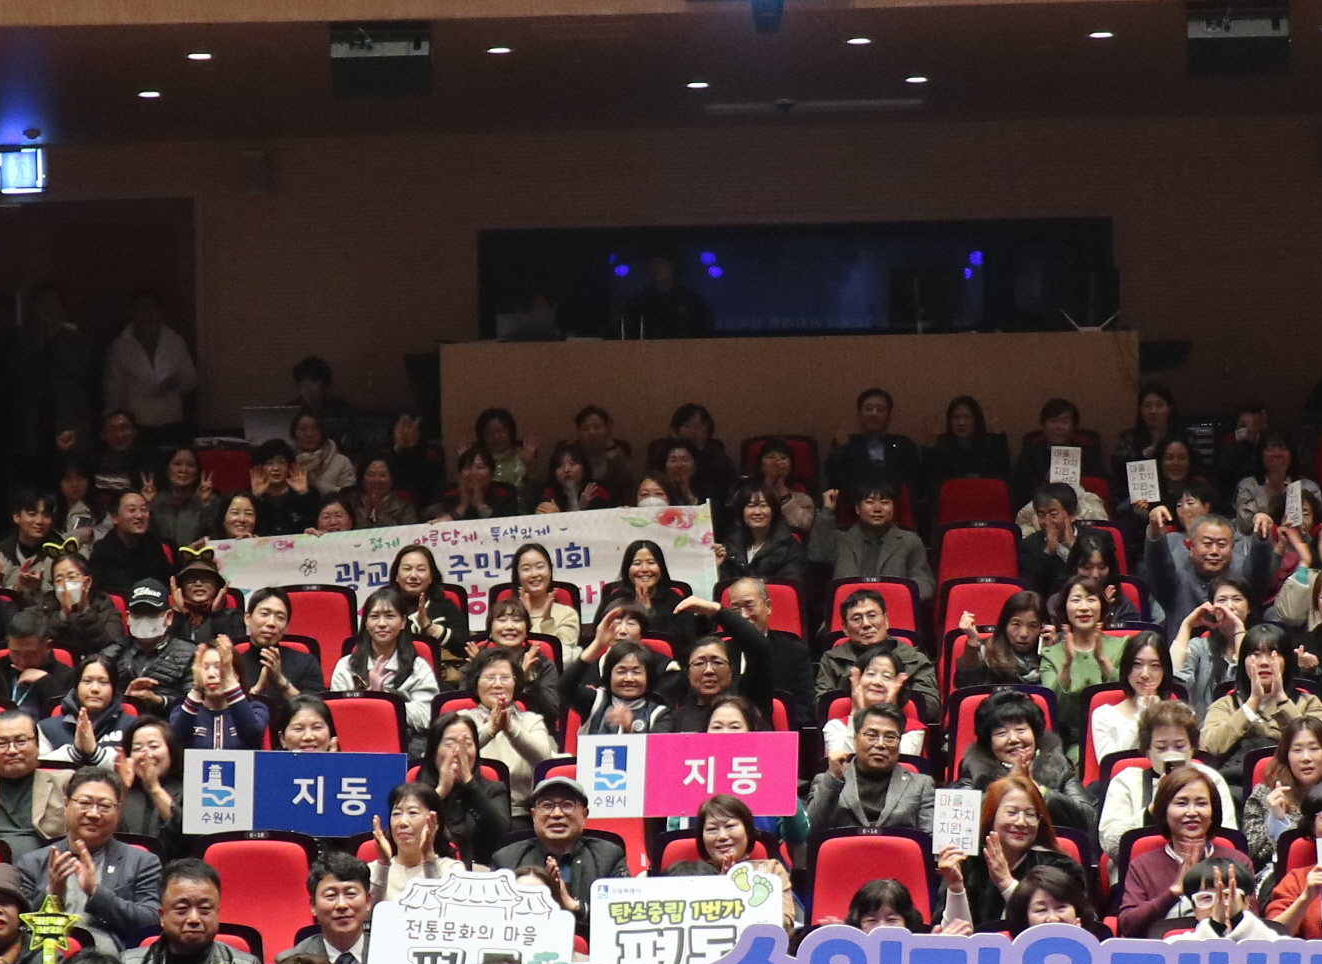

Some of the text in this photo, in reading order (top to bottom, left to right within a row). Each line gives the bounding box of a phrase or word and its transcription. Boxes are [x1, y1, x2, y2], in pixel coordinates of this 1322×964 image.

[370, 537, 400, 550] 젊게
[490, 525, 551, 542] 특색있게
[334, 543, 590, 592] 광교 주민회
[683, 756, 762, 794] 지동
[292, 776, 371, 816] 지동
[592, 795, 626, 807] 수원시
[940, 794, 963, 806] 마을
[201, 812, 235, 824] 수원시
[952, 809, 974, 821] 자치
[939, 822, 962, 834] 지원
[949, 837, 973, 850] 센터
[609, 899, 745, 924] 탄소중립 1번가
[405, 920, 537, 946] 전통문화의 마을
